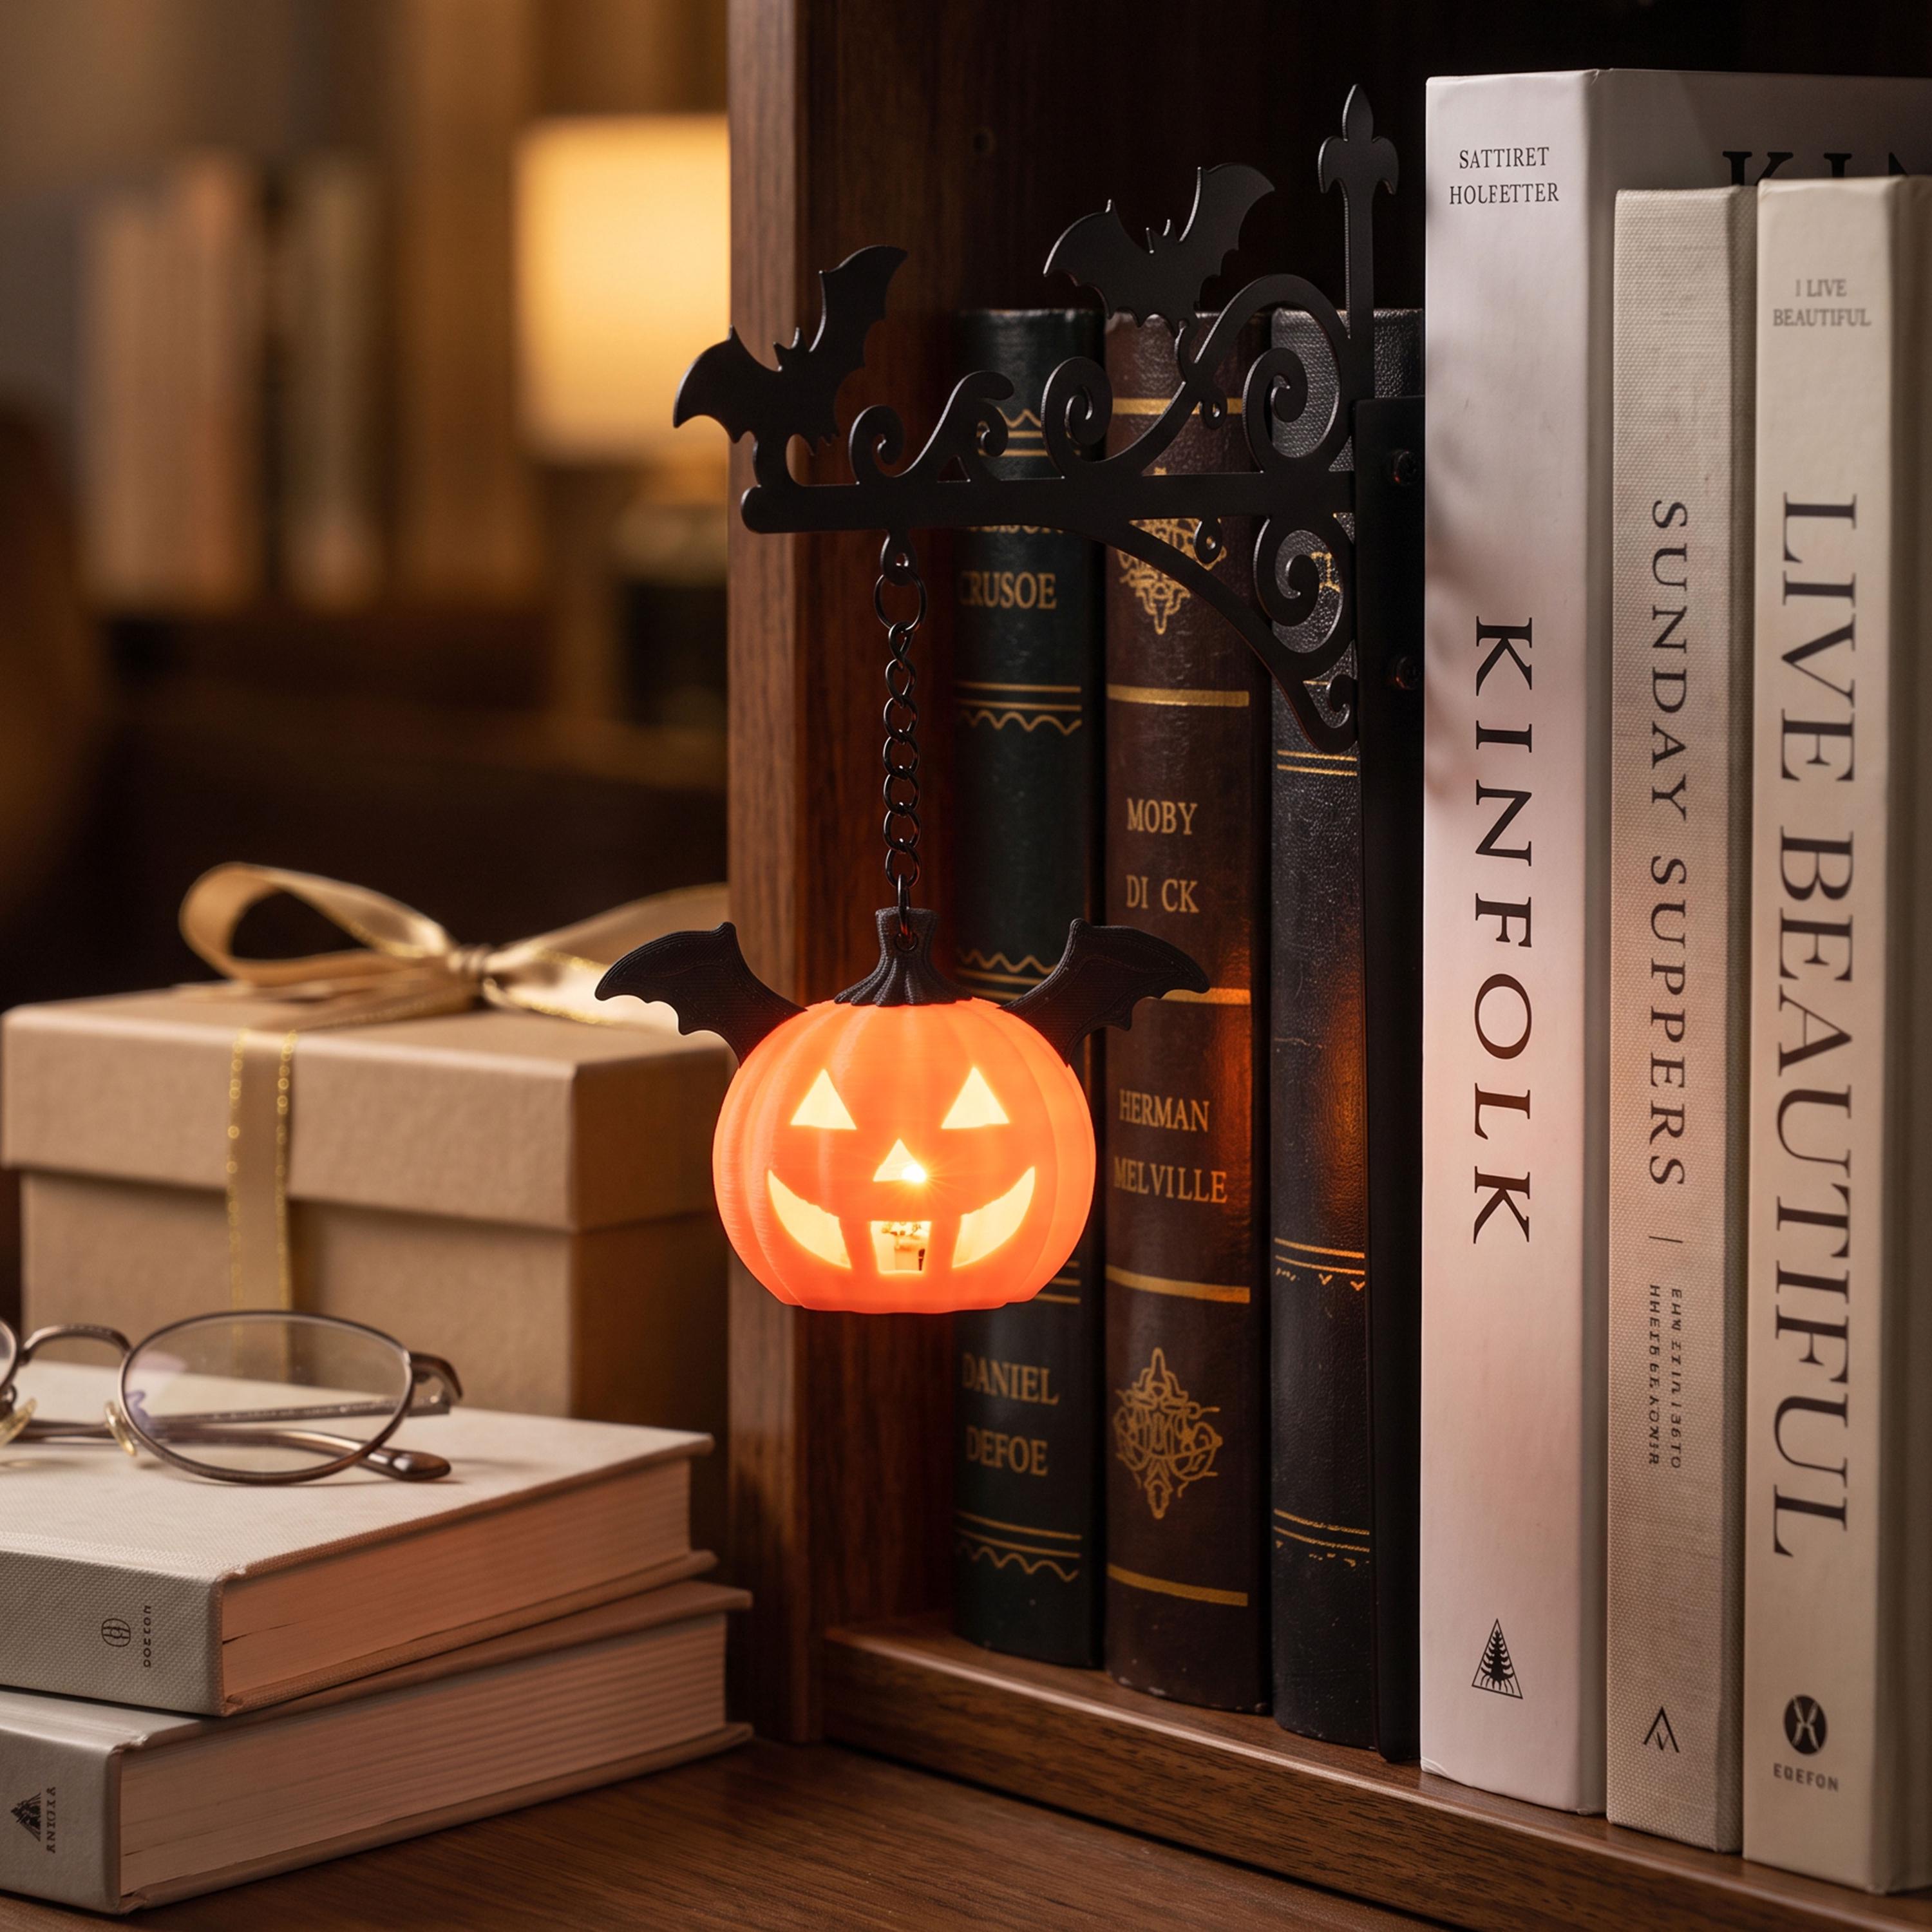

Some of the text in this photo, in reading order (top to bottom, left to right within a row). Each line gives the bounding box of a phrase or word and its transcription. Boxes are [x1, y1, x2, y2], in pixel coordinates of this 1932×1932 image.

[1459, 146, 1549, 169] SATTIRET
[1806, 278, 1848, 298] LIVE
[1772, 307, 1872, 327] BEAUTIFUL
[1126, 798, 1198, 835] MOBY
[1649, 500, 1689, 1185] SUNDAY SUPPERS
[1473, 616, 1533, 1244] KINFOLK
[1773, 491, 1857, 1558] LIVE BEAUTIFUL
[1119, 1088, 1211, 1132] HERMAN
[1113, 1157, 1228, 1204] MELVILLE
[962, 1352, 1059, 1406] DANIEL
[966, 1425, 1048, 1477] DEFOE
